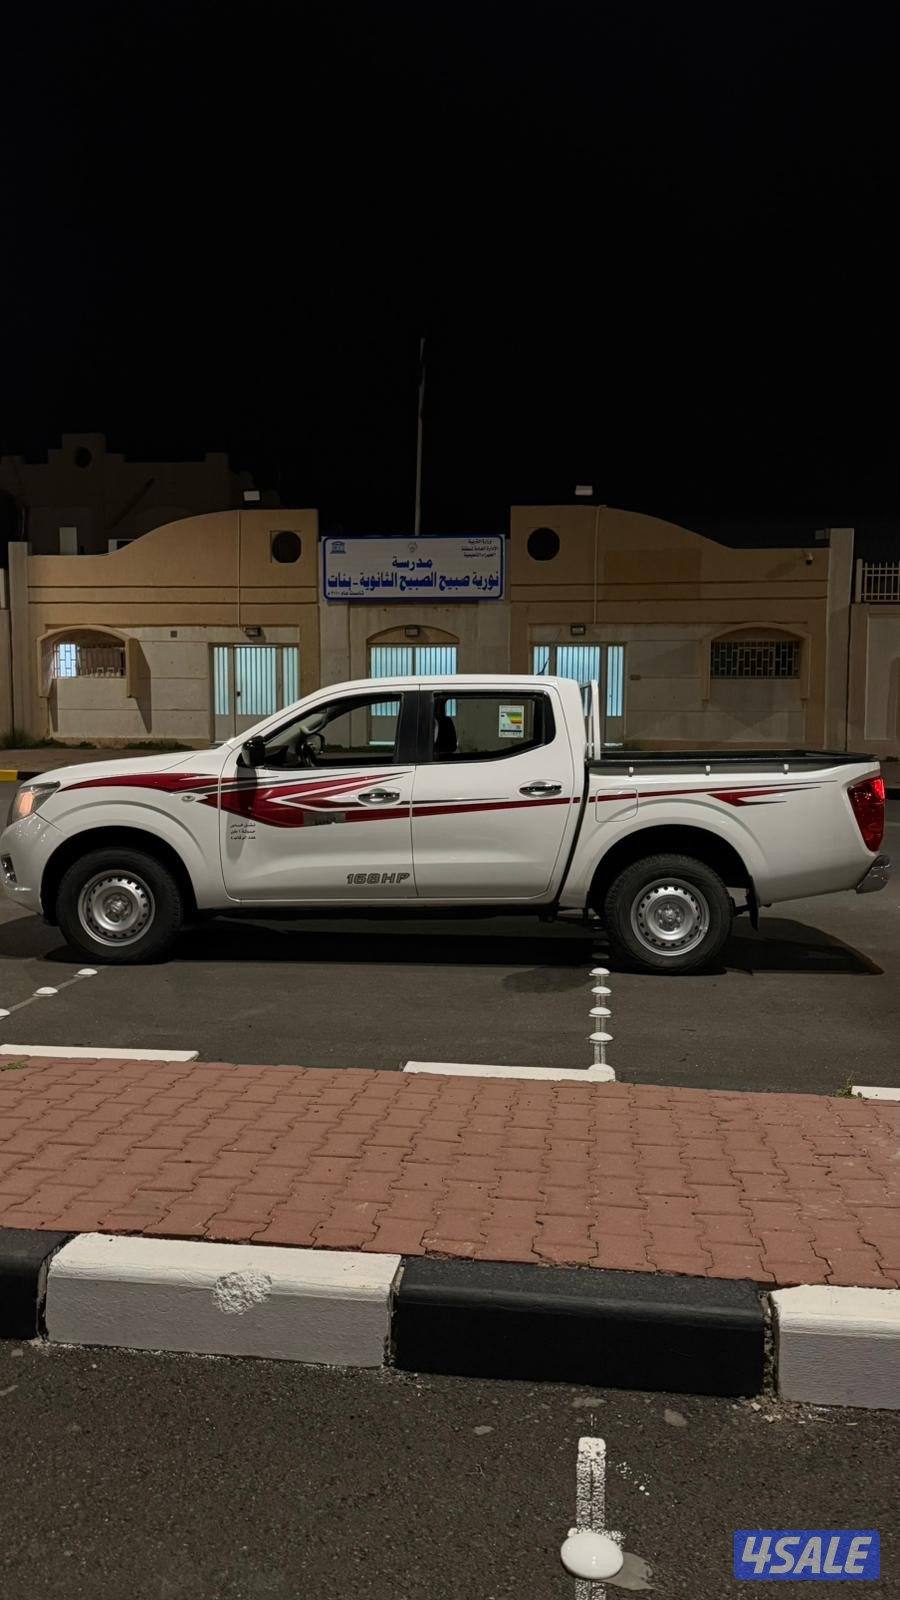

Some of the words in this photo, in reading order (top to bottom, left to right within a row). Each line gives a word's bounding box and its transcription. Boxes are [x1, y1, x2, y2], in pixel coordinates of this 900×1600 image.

[392, 555, 433, 571] مدرسة
[328, 572, 352, 590] بنات
[360, 571, 397, 591] الثانوية
[400, 572, 437, 591] الصبيح
[439, 575, 470, 591] صبيح
[472, 571, 499, 590] نورية
[346, 872, 410, 884] 168HP
